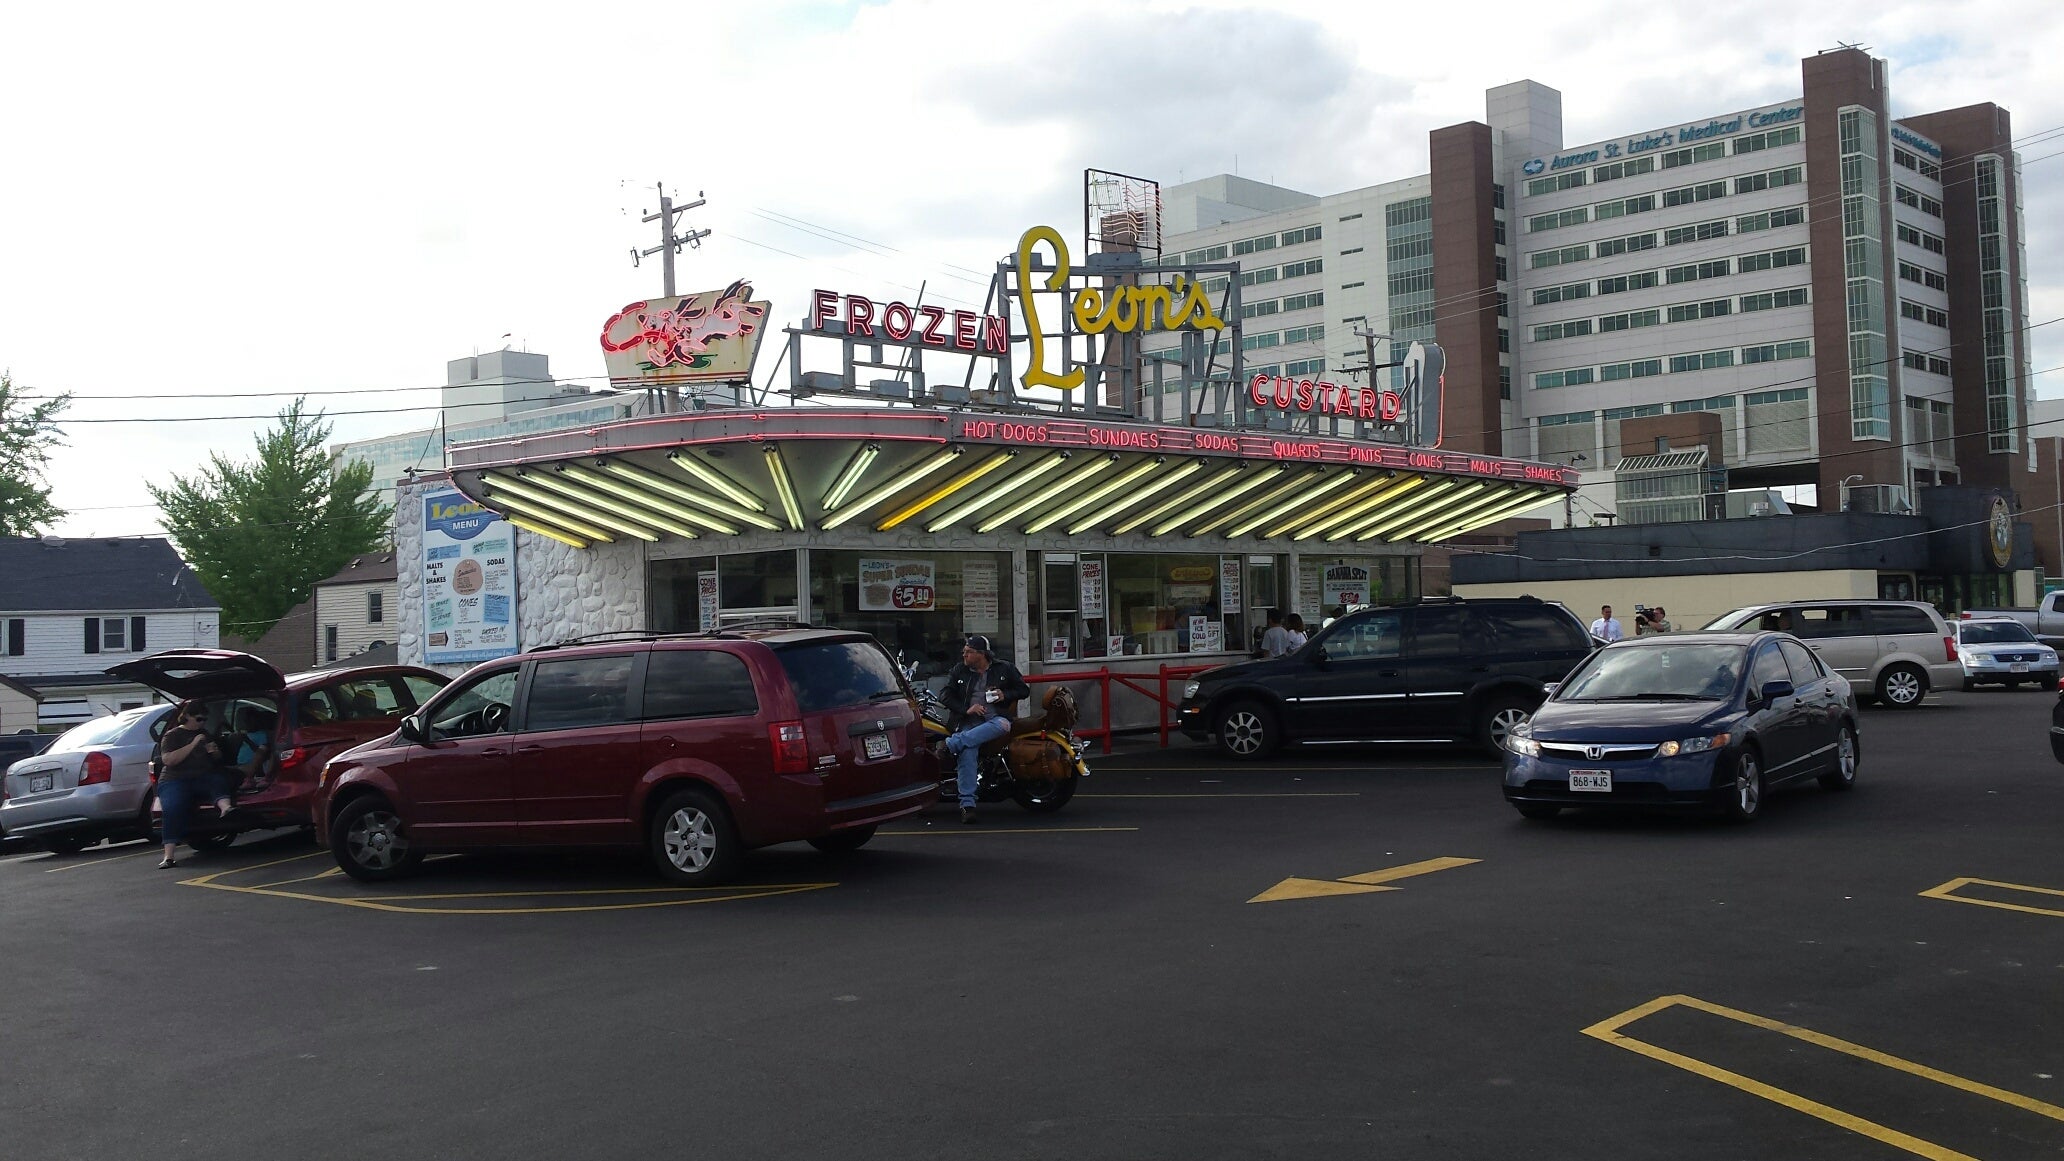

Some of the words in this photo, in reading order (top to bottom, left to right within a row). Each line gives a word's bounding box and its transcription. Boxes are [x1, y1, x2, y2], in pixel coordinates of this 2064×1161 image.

[1550, 150, 1599, 170] Aurora
[1604, 142, 1622, 159] St.
[1627, 131, 1673, 154] Luke's
[1679, 115, 1742, 144] Medical
[1748, 106, 1804, 129] Center
[1015, 225, 1225, 390] Leon's
[811, 289, 1008, 354] FROZEN
[1252, 374, 1401, 421] CUSTARD
[964, 421, 997, 439] HOT
[1003, 423, 1047, 442] DOGS
[1089, 428, 1159, 448] SUNDAES
[1195, 433, 1239, 452] SODAS
[1273, 441, 1321, 459] QUARTS
[1350, 447, 1382, 463] PINTS
[1409, 453, 1443, 469] CONES
[1471, 460, 1501, 475] MALTS
[1525, 466, 1562, 482] SHAKES
[452, 520, 479, 530] MENU
[427, 562, 443, 571] MALTS
[487, 558, 505, 566] SODAS
[868, 561, 890, 569] LEON'S
[1082, 563, 1099, 571] CONE
[426, 576, 446, 584] SHAKES
[1326, 566, 1351, 580] BANANA
[1351, 567, 1368, 580] SPLIT
[1192, 632, 1206, 640] COLD
[1208, 630, 1219, 638] GIFT
[1573, 776, 1608, 787] 868-WJS
